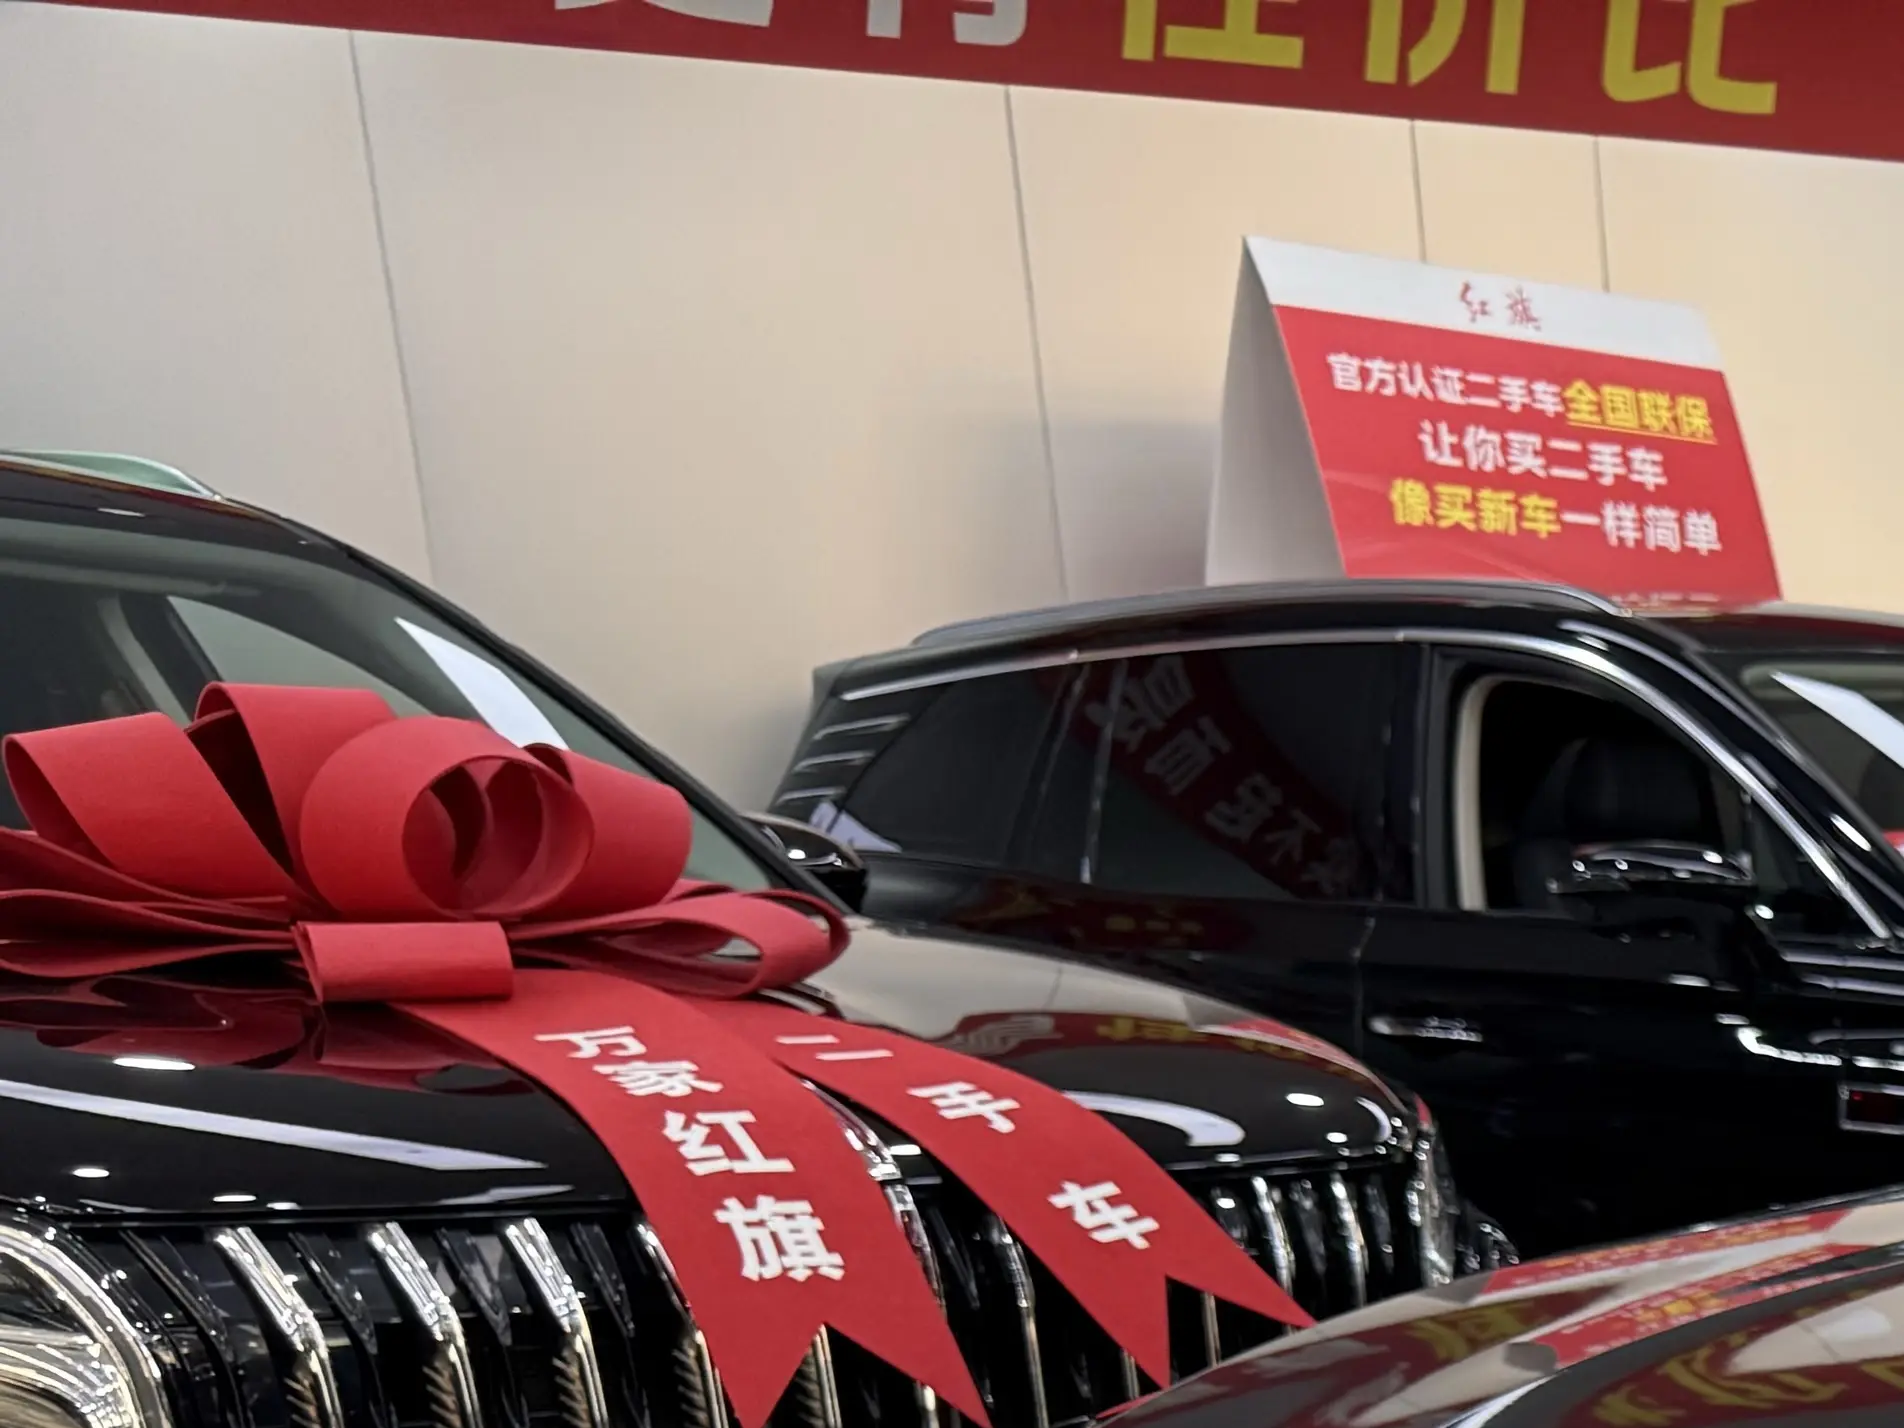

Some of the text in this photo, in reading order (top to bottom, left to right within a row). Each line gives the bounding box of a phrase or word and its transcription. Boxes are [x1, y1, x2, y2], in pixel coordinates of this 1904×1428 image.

[1459, 281, 1543, 331] 红旗
[1326, 352, 1714, 439] 官方认证二手车全国联保
[1418, 420, 1668, 491] 让你买二手车
[1389, 477, 1723, 556] 像买新车一样简单
[533, 1025, 846, 1281] 万家红旗
[776, 1033, 1162, 1251] 二手车
